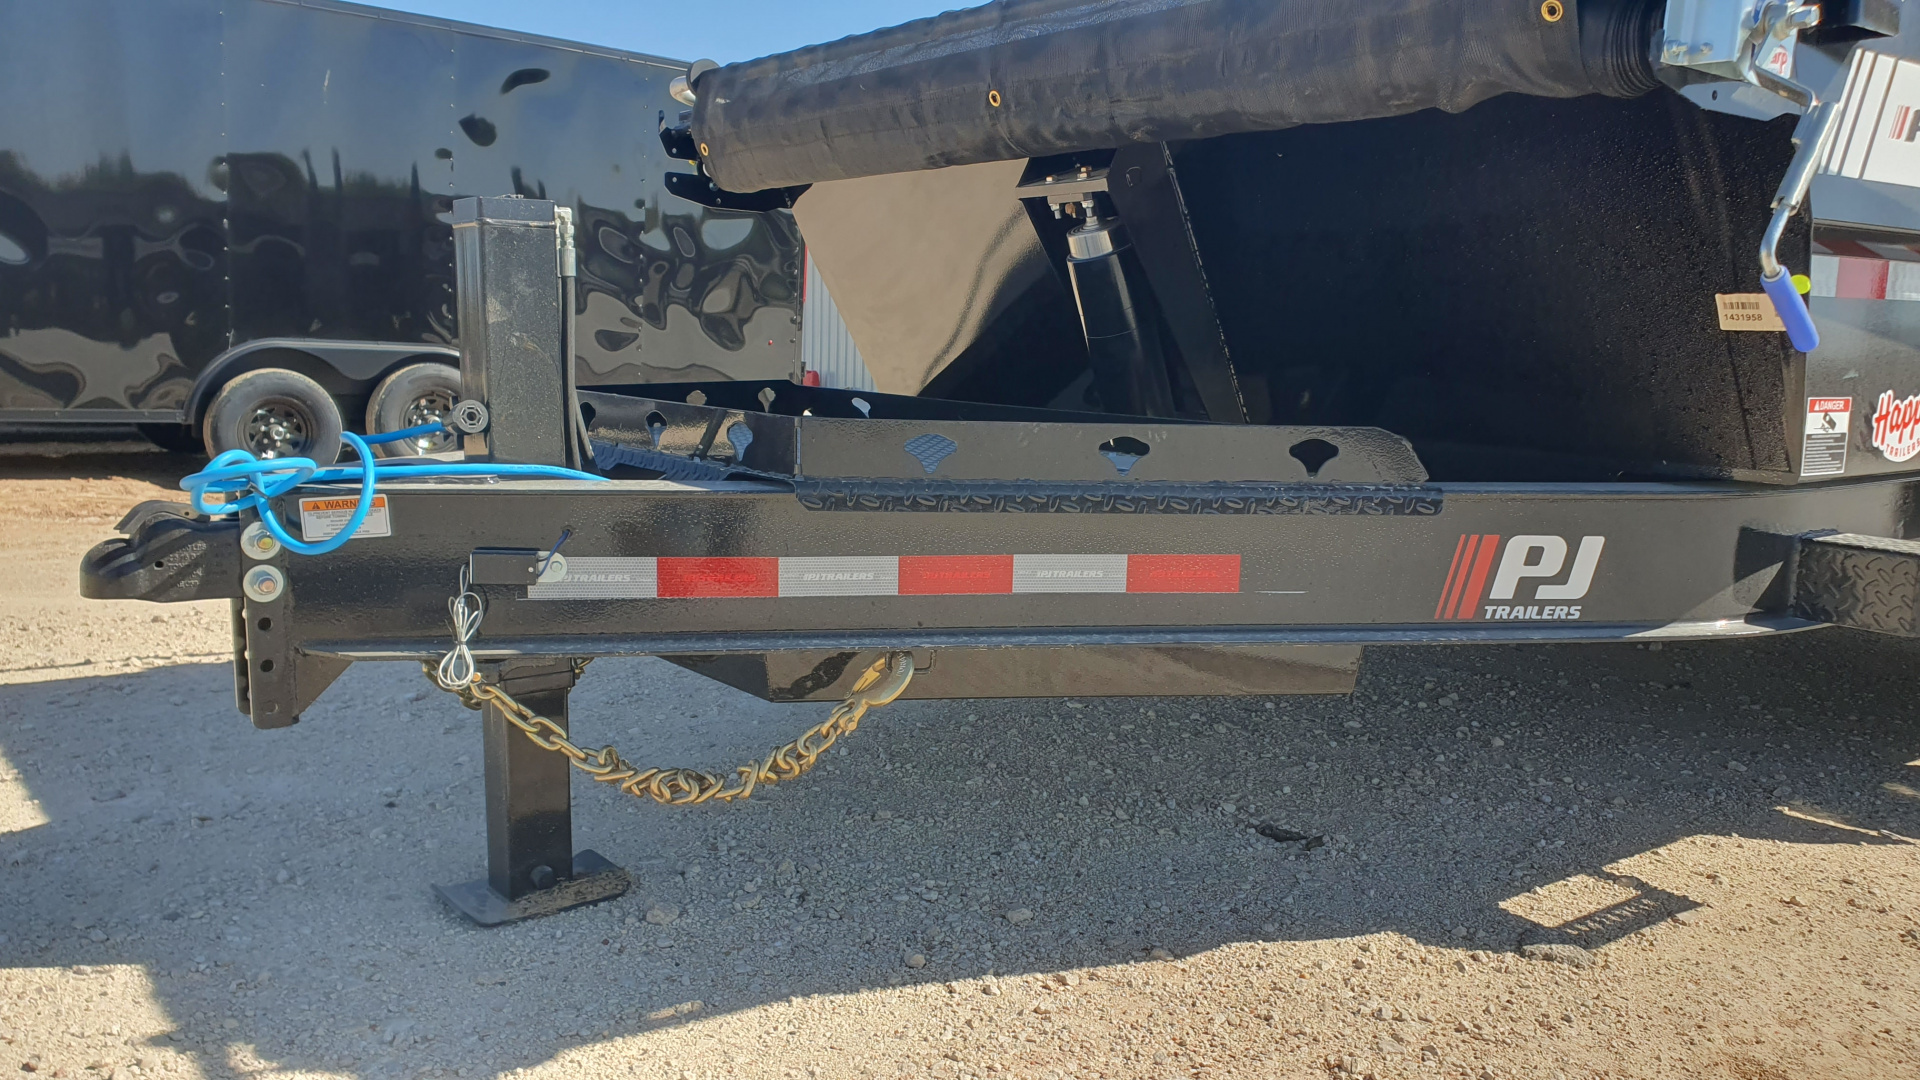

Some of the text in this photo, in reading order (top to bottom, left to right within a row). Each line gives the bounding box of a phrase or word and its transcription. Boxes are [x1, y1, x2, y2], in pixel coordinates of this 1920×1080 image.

[1723, 313, 1763, 322] 1431958
[1819, 400, 1845, 411] DANGER
[1489, 534, 1606, 600] PJ
[573, 574, 631, 582] TRAILERS
[820, 572, 874, 581] TRAILERS
[1053, 570, 1103, 578] TRAILERS
[1484, 605, 1582, 620] TRAILERS
